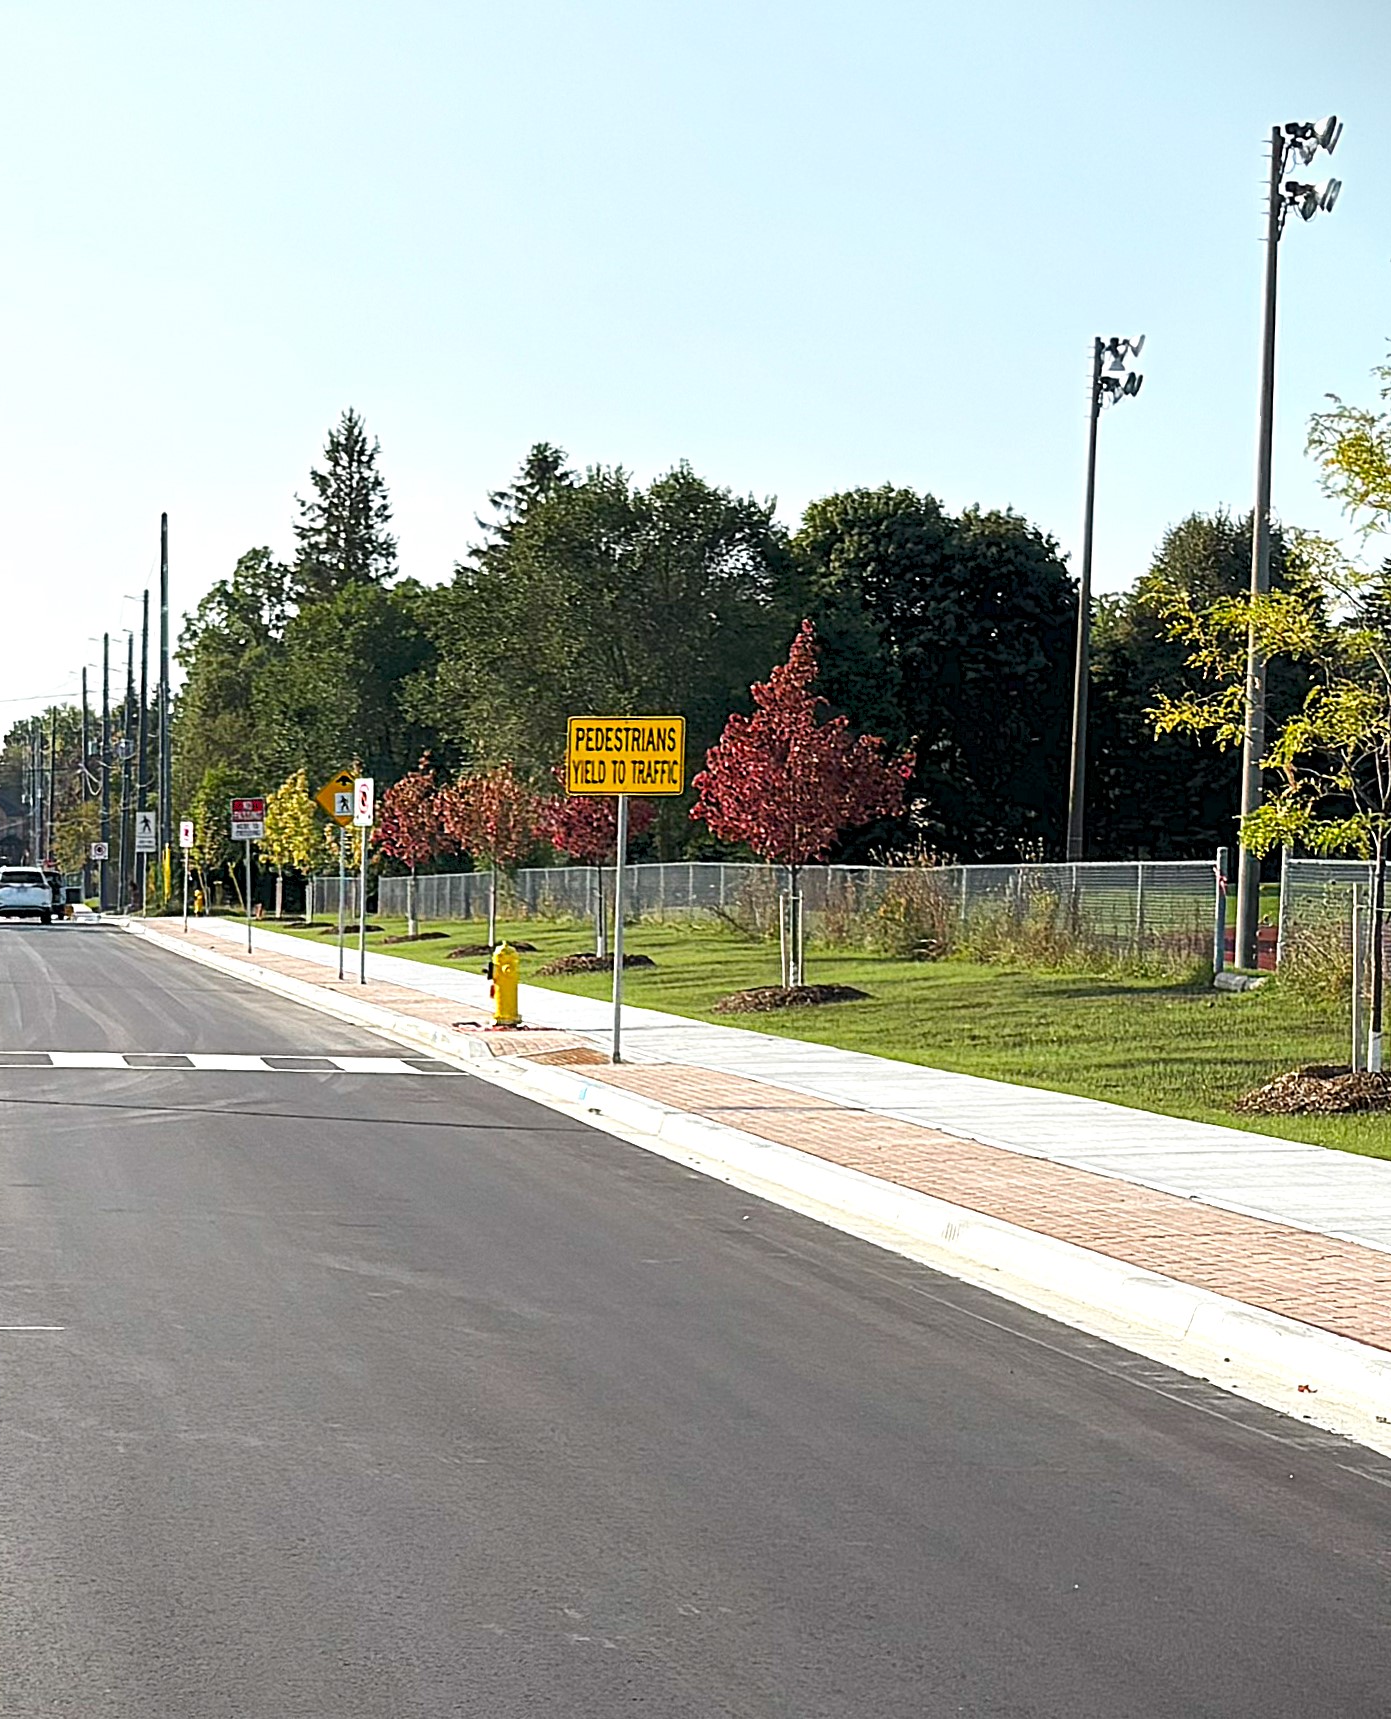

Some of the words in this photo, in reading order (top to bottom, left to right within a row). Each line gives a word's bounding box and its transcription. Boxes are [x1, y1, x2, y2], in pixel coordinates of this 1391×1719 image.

[575, 727, 676, 752] PEDESTRIANS
[572, 760, 606, 784] YIELD
[611, 760, 626, 784] TO
[631, 760, 679, 784] TRAFFIC
